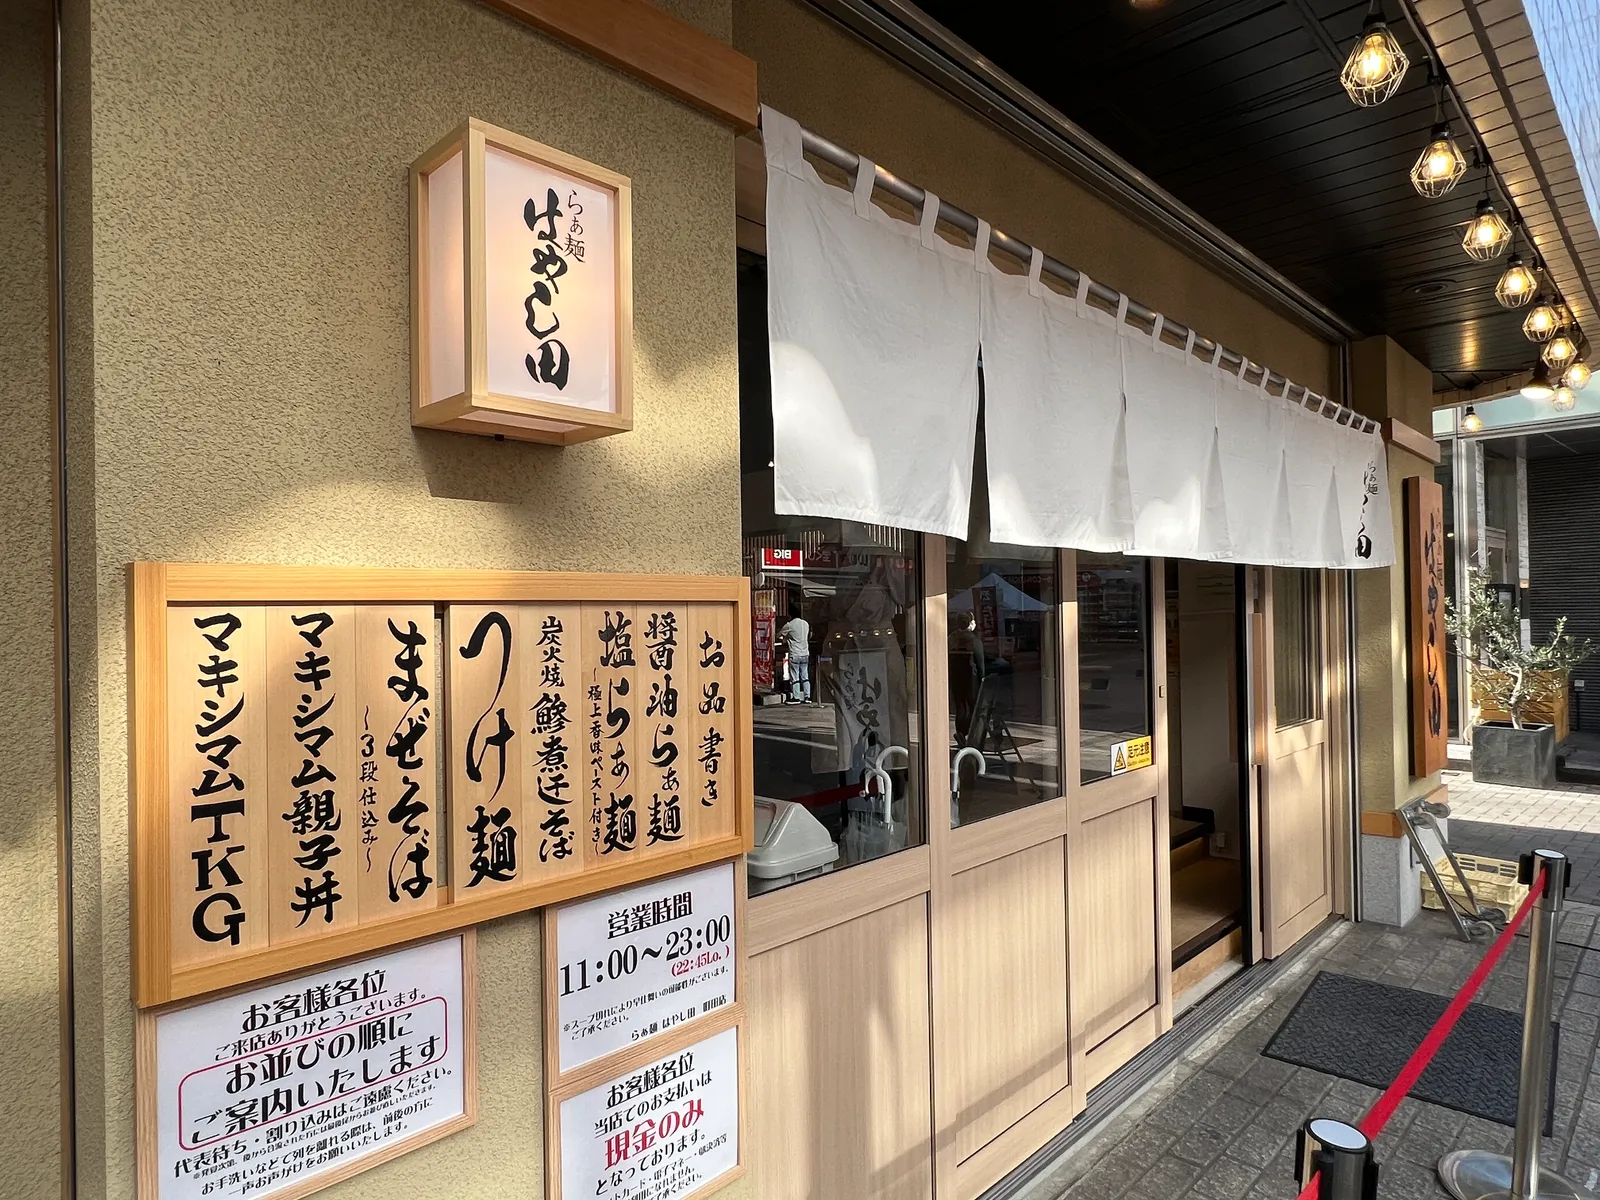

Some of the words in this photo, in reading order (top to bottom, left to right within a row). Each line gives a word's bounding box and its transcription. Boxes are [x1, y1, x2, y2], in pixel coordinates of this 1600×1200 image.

[564, 189, 586, 263] らぁ麺
[523, 188, 570, 391] はやし田
[385, 617, 434, 903] まぜそば
[459, 611, 518, 888] つけ麺
[697, 630, 726, 807] お品書き
[190, 612, 246, 946] マキシマムTKG
[281, 611, 343, 929] マキシマム親子丼
[607, 891, 693, 940] 営業時間
[215, 987, 428, 1061] ご来店ありがとうございます。
[240, 969, 388, 1034] お客様各位
[191, 1034, 441, 1143] ご案内いたします
[226, 1011, 413, 1094] お並びの順に
[606, 1051, 695, 1110] お客様各位
[174, 1067, 452, 1178] 代表待ち・割り込みはご遠慮ください。
[596, 1128, 706, 1196] となっております。
[604, 1098, 705, 1171] 現金のみ
